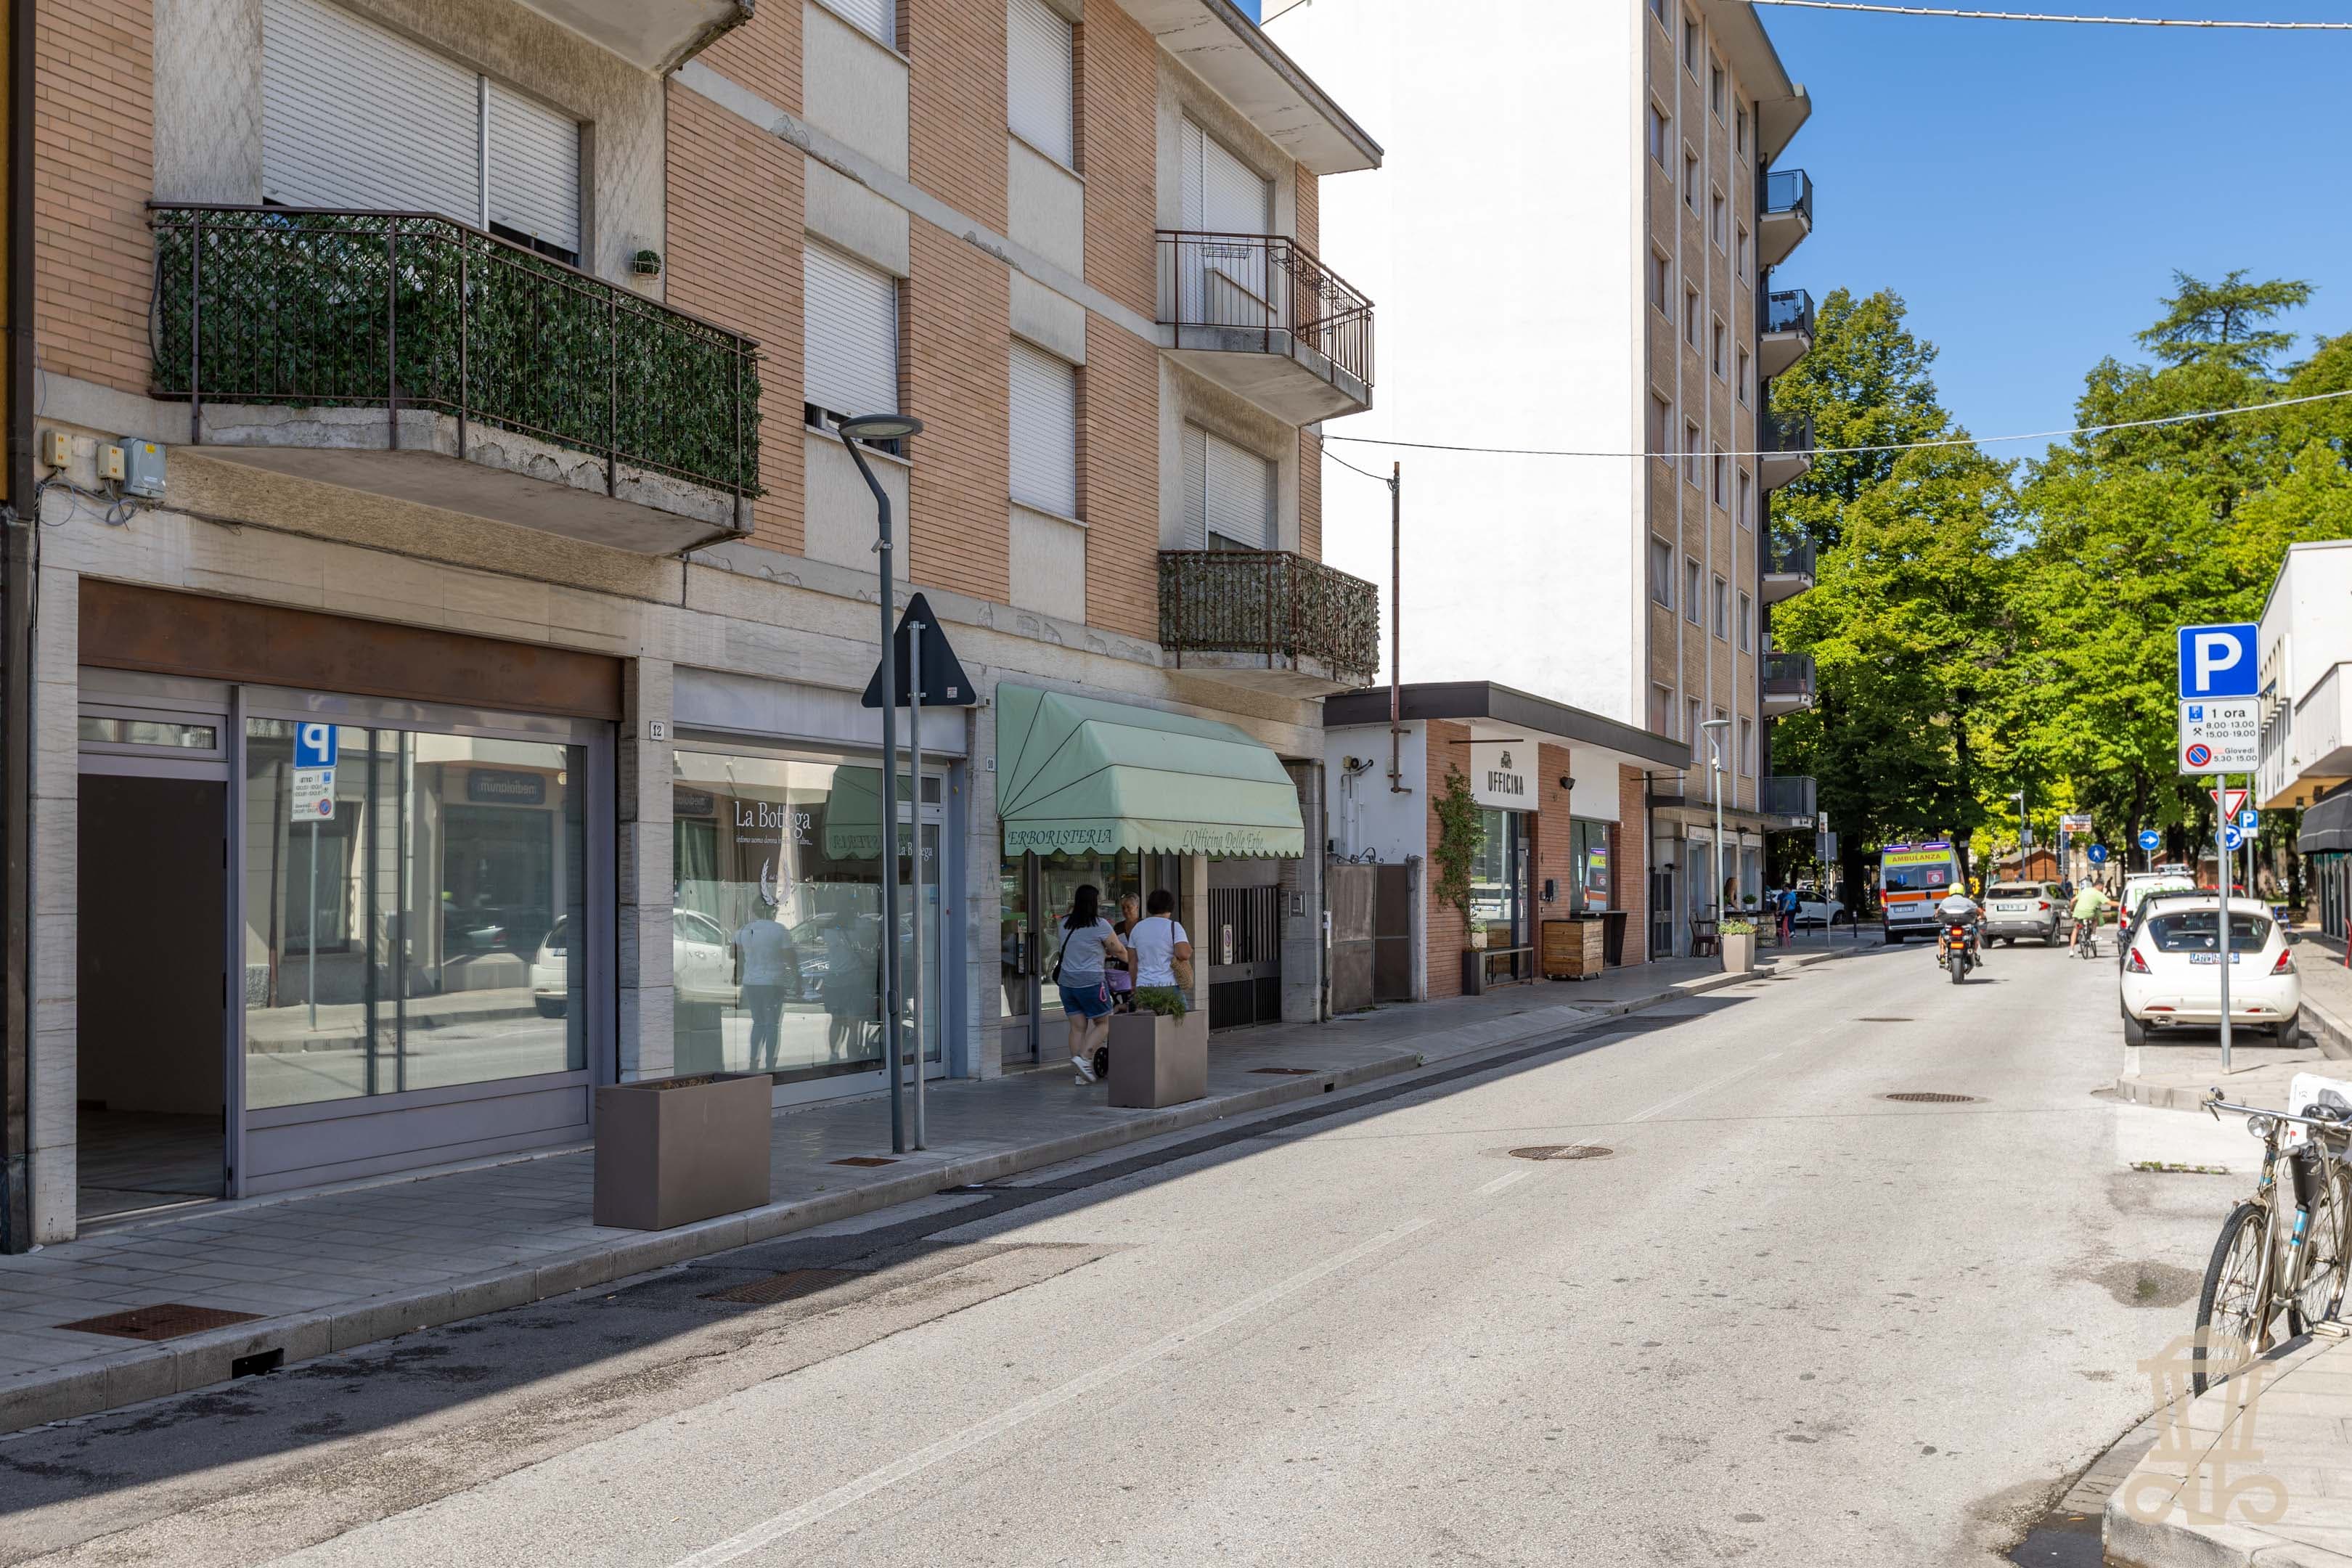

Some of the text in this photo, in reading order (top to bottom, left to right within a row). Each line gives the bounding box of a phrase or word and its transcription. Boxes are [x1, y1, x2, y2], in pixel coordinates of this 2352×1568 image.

[2195, 632, 2242, 691] P
[2212, 709, 2246, 718] 1 ora
[653, 724, 661, 736] 12
[988, 759, 994, 769] 10
[1488, 771, 1524, 796] UFFICINA
[735, 801, 754, 827] La
[757, 801, 812, 838] Bottega
[2243, 812, 2254, 827] P
[1008, 829, 1113, 847] ERBORISTERIA
[1183, 828, 1265, 854] L'Officina Delle Erbe
[1892, 853, 1941, 862] AMBULANZA
